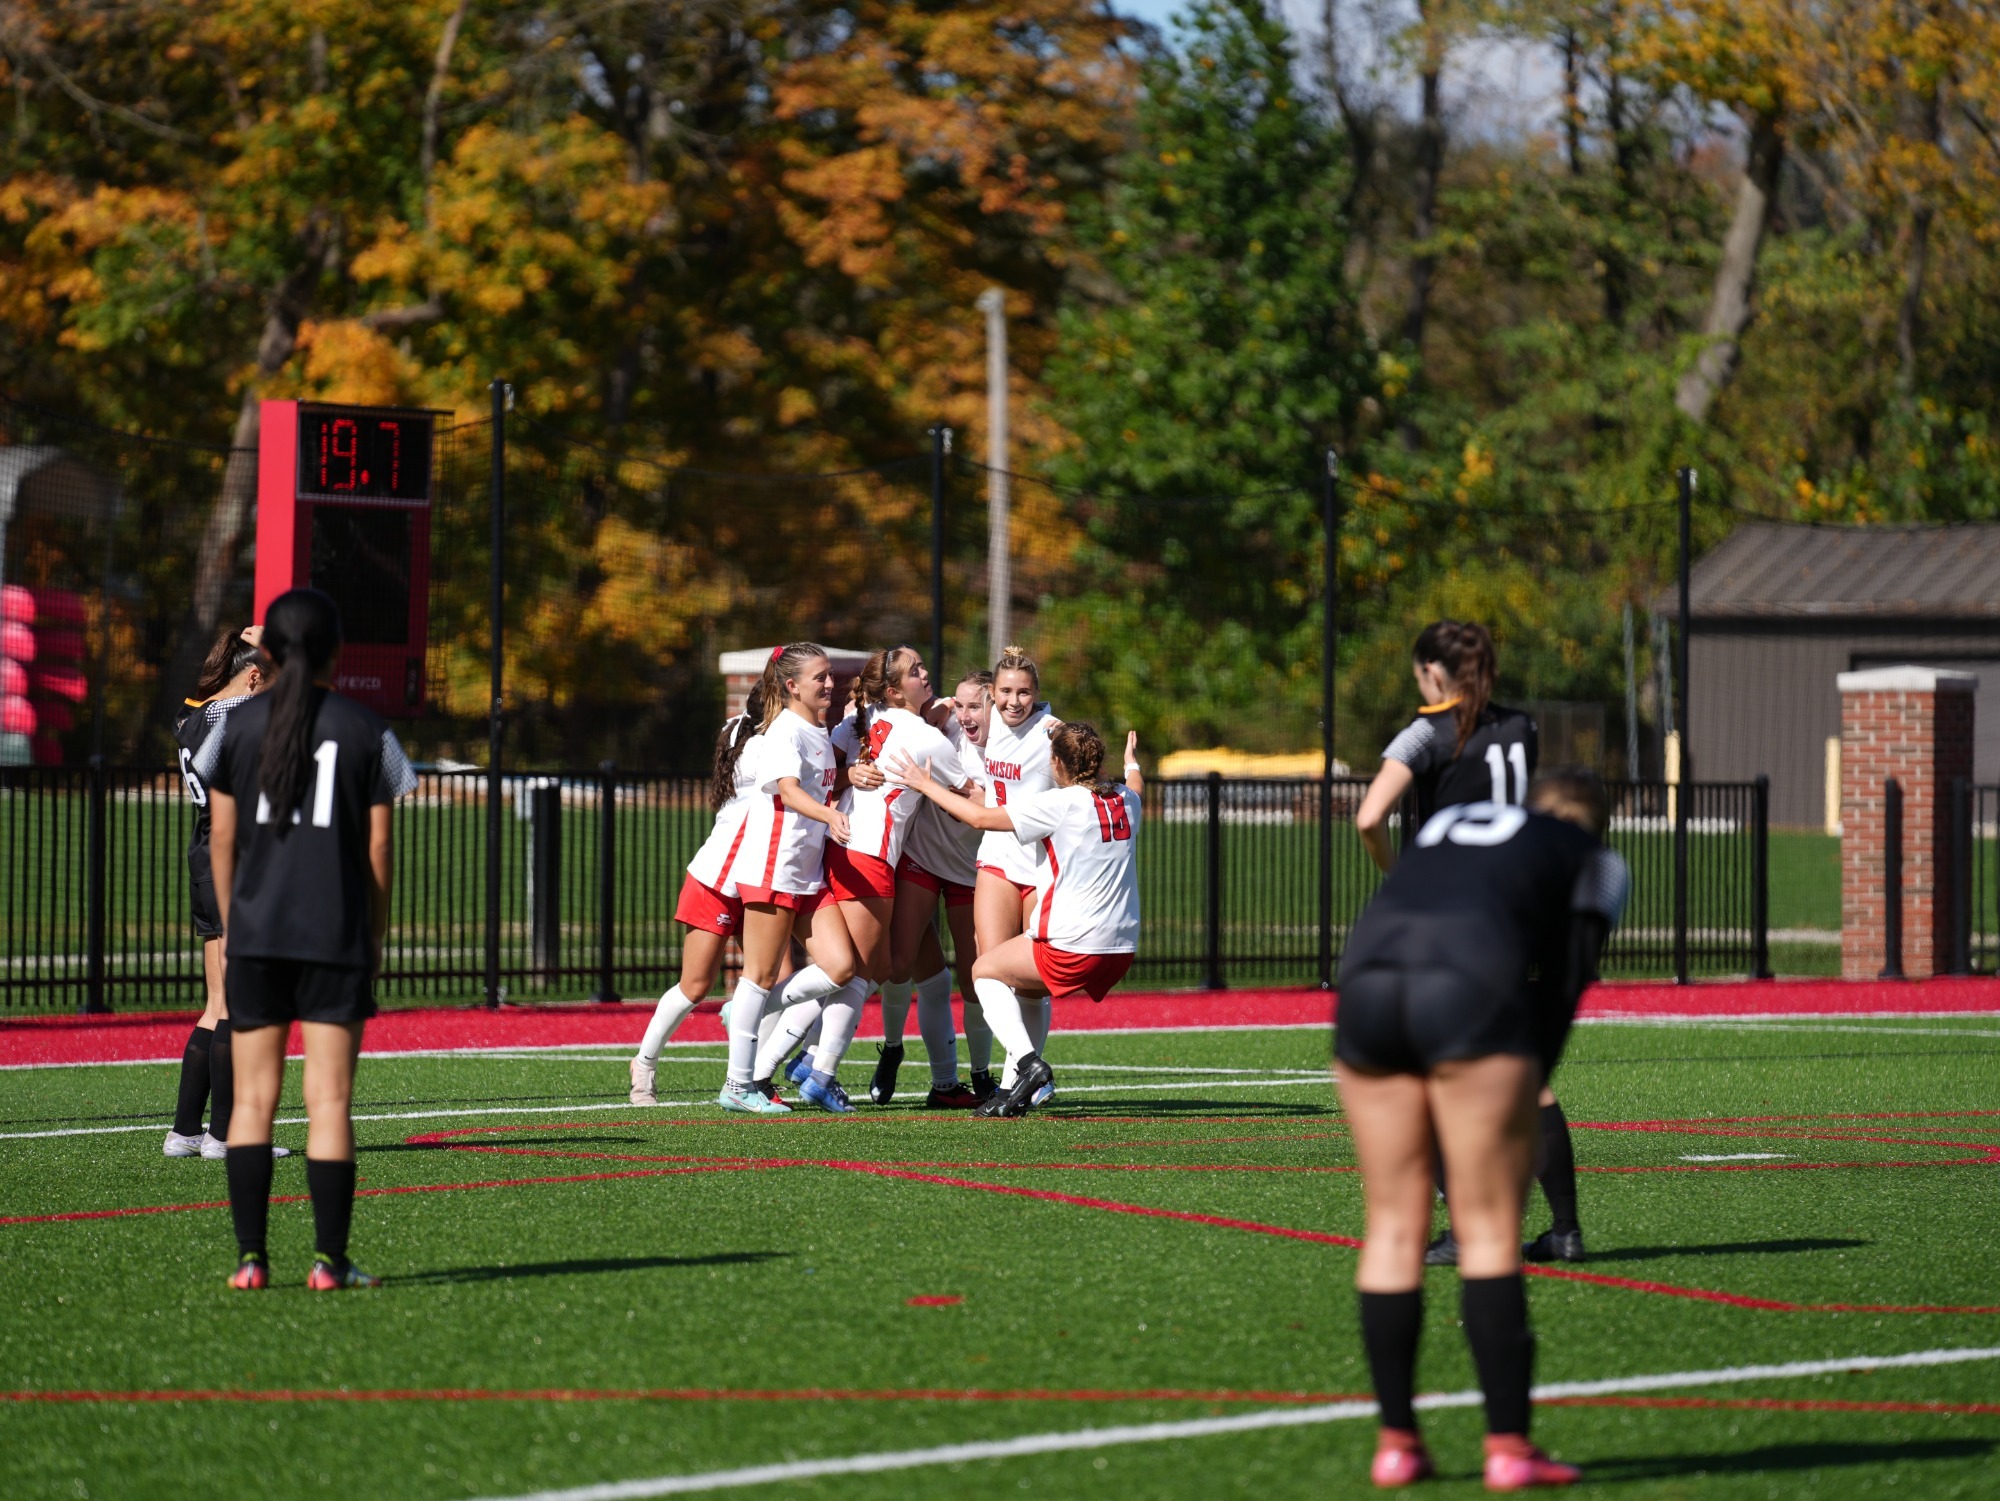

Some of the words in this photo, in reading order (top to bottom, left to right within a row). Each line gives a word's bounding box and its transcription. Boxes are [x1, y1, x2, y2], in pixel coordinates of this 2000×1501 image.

[985, 757, 1022, 781] ENISON
[1484, 742, 1528, 811] 11
[994, 779, 1007, 807] 9
[1091, 789, 1132, 844] 18
